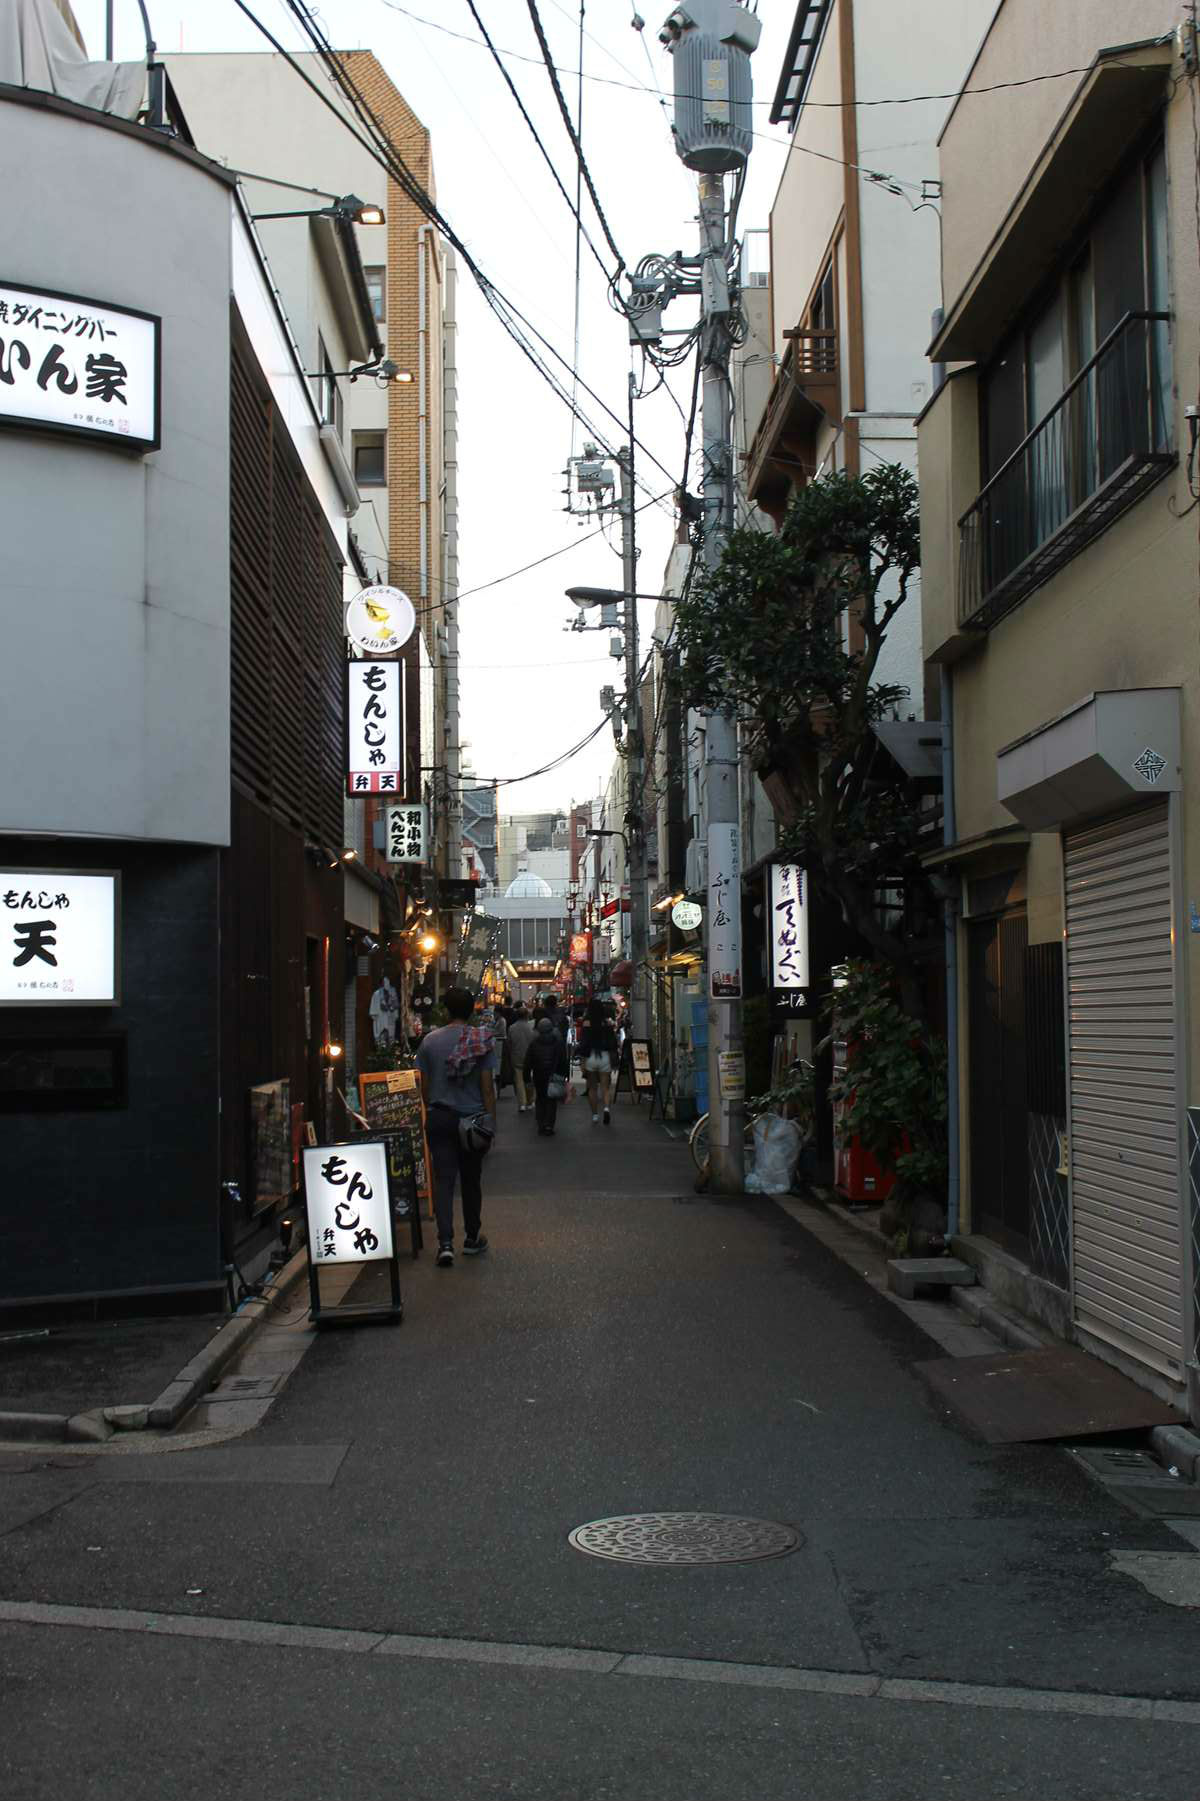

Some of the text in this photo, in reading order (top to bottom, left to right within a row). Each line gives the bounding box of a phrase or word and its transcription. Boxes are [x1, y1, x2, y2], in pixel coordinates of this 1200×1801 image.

[354, 774, 397, 790] 弁天
[406, 810, 422, 858] 和小物
[12, 919, 58, 968] 天
[775, 898, 802, 983] てぬぐい
[322, 1227, 337, 1257] 弁天
